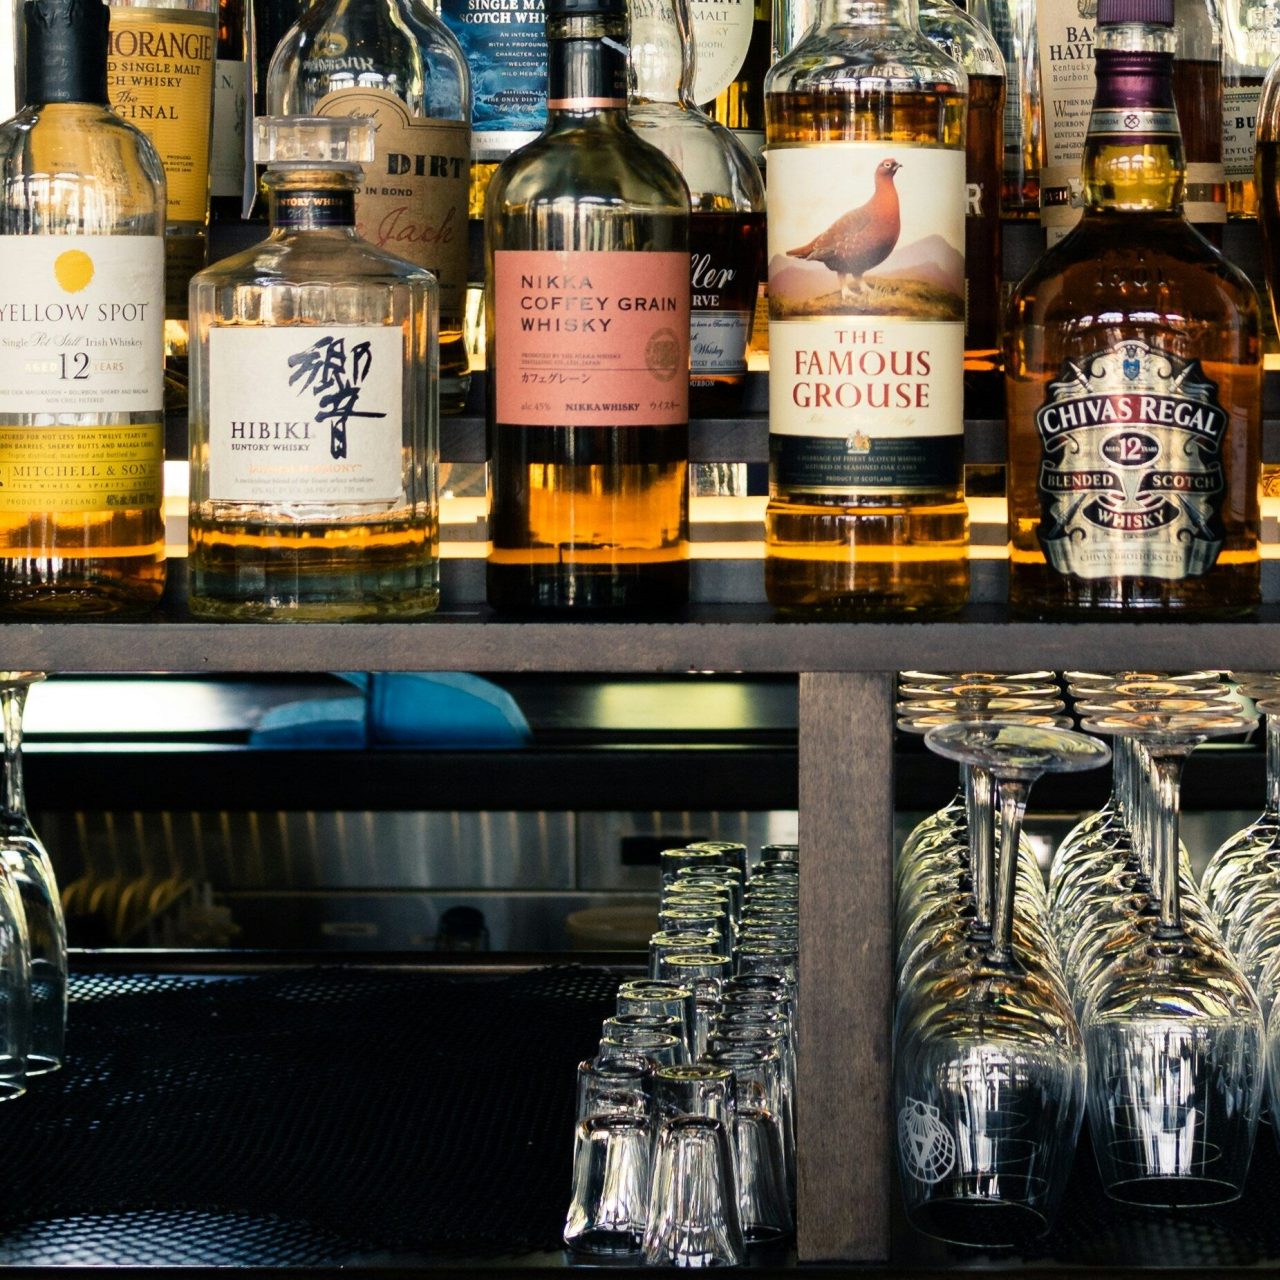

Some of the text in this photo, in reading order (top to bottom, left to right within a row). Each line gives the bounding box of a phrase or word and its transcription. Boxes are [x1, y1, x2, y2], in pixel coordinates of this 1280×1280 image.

[469, 0, 546, 10] SINGLE MA
[460, 12, 512, 24] SCOTCH
[108, 31, 212, 61] ORANGIE
[122, 63, 170, 73] SINGLE
[174, 65, 201, 76] MALT
[1053, 64, 1092, 72] Kentucky
[132, 76, 182, 88] WHISKY
[1053, 73, 1089, 82] Bourbon
[116, 88, 138, 104] The
[365, 188, 413, 197] IN BOND
[691, 254, 736, 289] ller
[521, 275, 593, 289] NIKKA
[98, 302, 149, 322] SPOT
[521, 297, 609, 311] COFFEY
[618, 298, 677, 312] GRAIN
[521, 318, 612, 333] WHISKY
[3, 339, 29, 349] Single
[86, 338, 108, 347] Irish
[110, 338, 144, 349] Whiskey
[834, 330, 884, 344] THE
[59, 352, 90, 380] 12
[795, 351, 931, 376] FAMOUS
[793, 382, 930, 409] GROUSE
[1043, 397, 1218, 436] CHIVAS REGAL
[231, 422, 311, 439] HIBIKI
[274, 444, 310, 452] WHISKY
[1120, 437, 1142, 461] 12
[13, 466, 116, 477] MITCHELL &
[1048, 471, 1215, 489] BLENDED SCOTCH
[1098, 509, 1165, 529] WHISKY
[1081, 553, 1112, 562] CHIVAS
